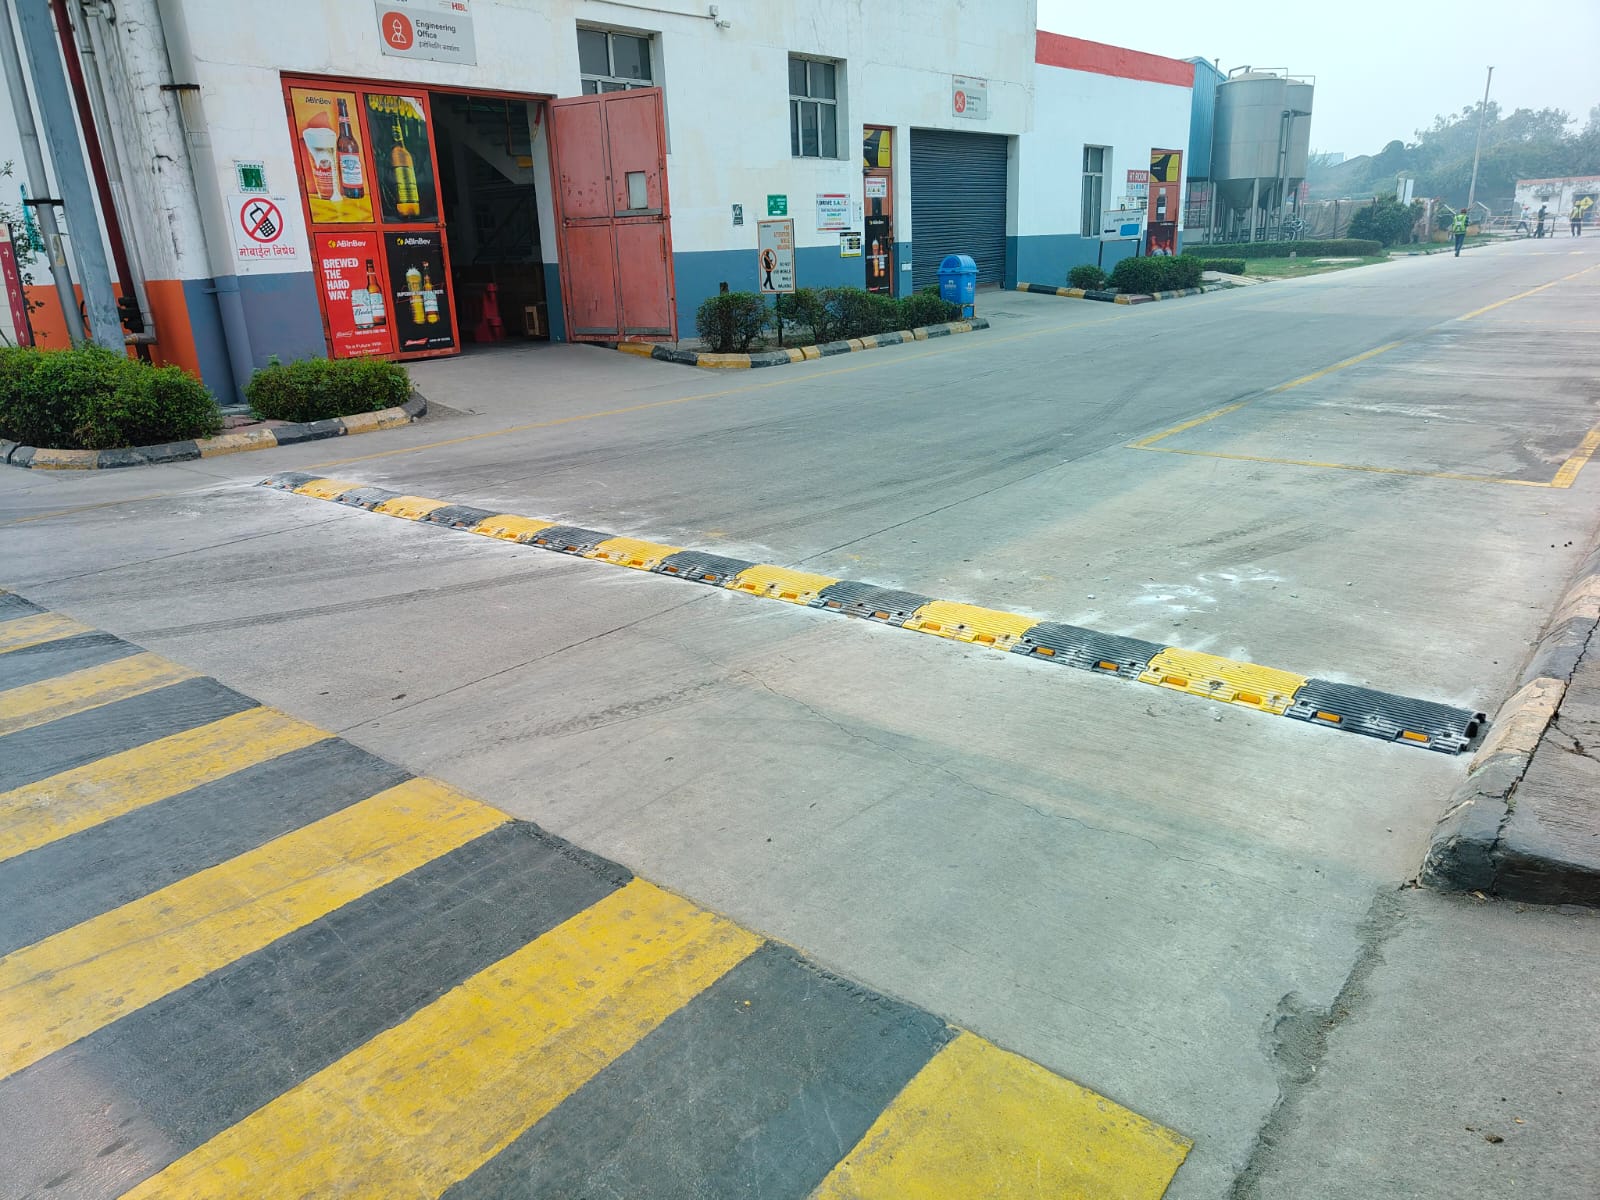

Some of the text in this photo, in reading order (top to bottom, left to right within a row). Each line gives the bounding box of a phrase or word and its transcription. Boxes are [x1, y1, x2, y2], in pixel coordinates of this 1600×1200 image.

[451, 2, 468, 12] HBL
[416, 19, 456, 34] Engineering
[416, 29, 438, 39] Office
[336, 240, 366, 248] ABInBev
[404, 238, 431, 246] ABInBev
[323, 259, 358, 269] BREWED
[325, 269, 342, 279] THE
[327, 280, 350, 290] HARD
[328, 290, 349, 301] WAY.
